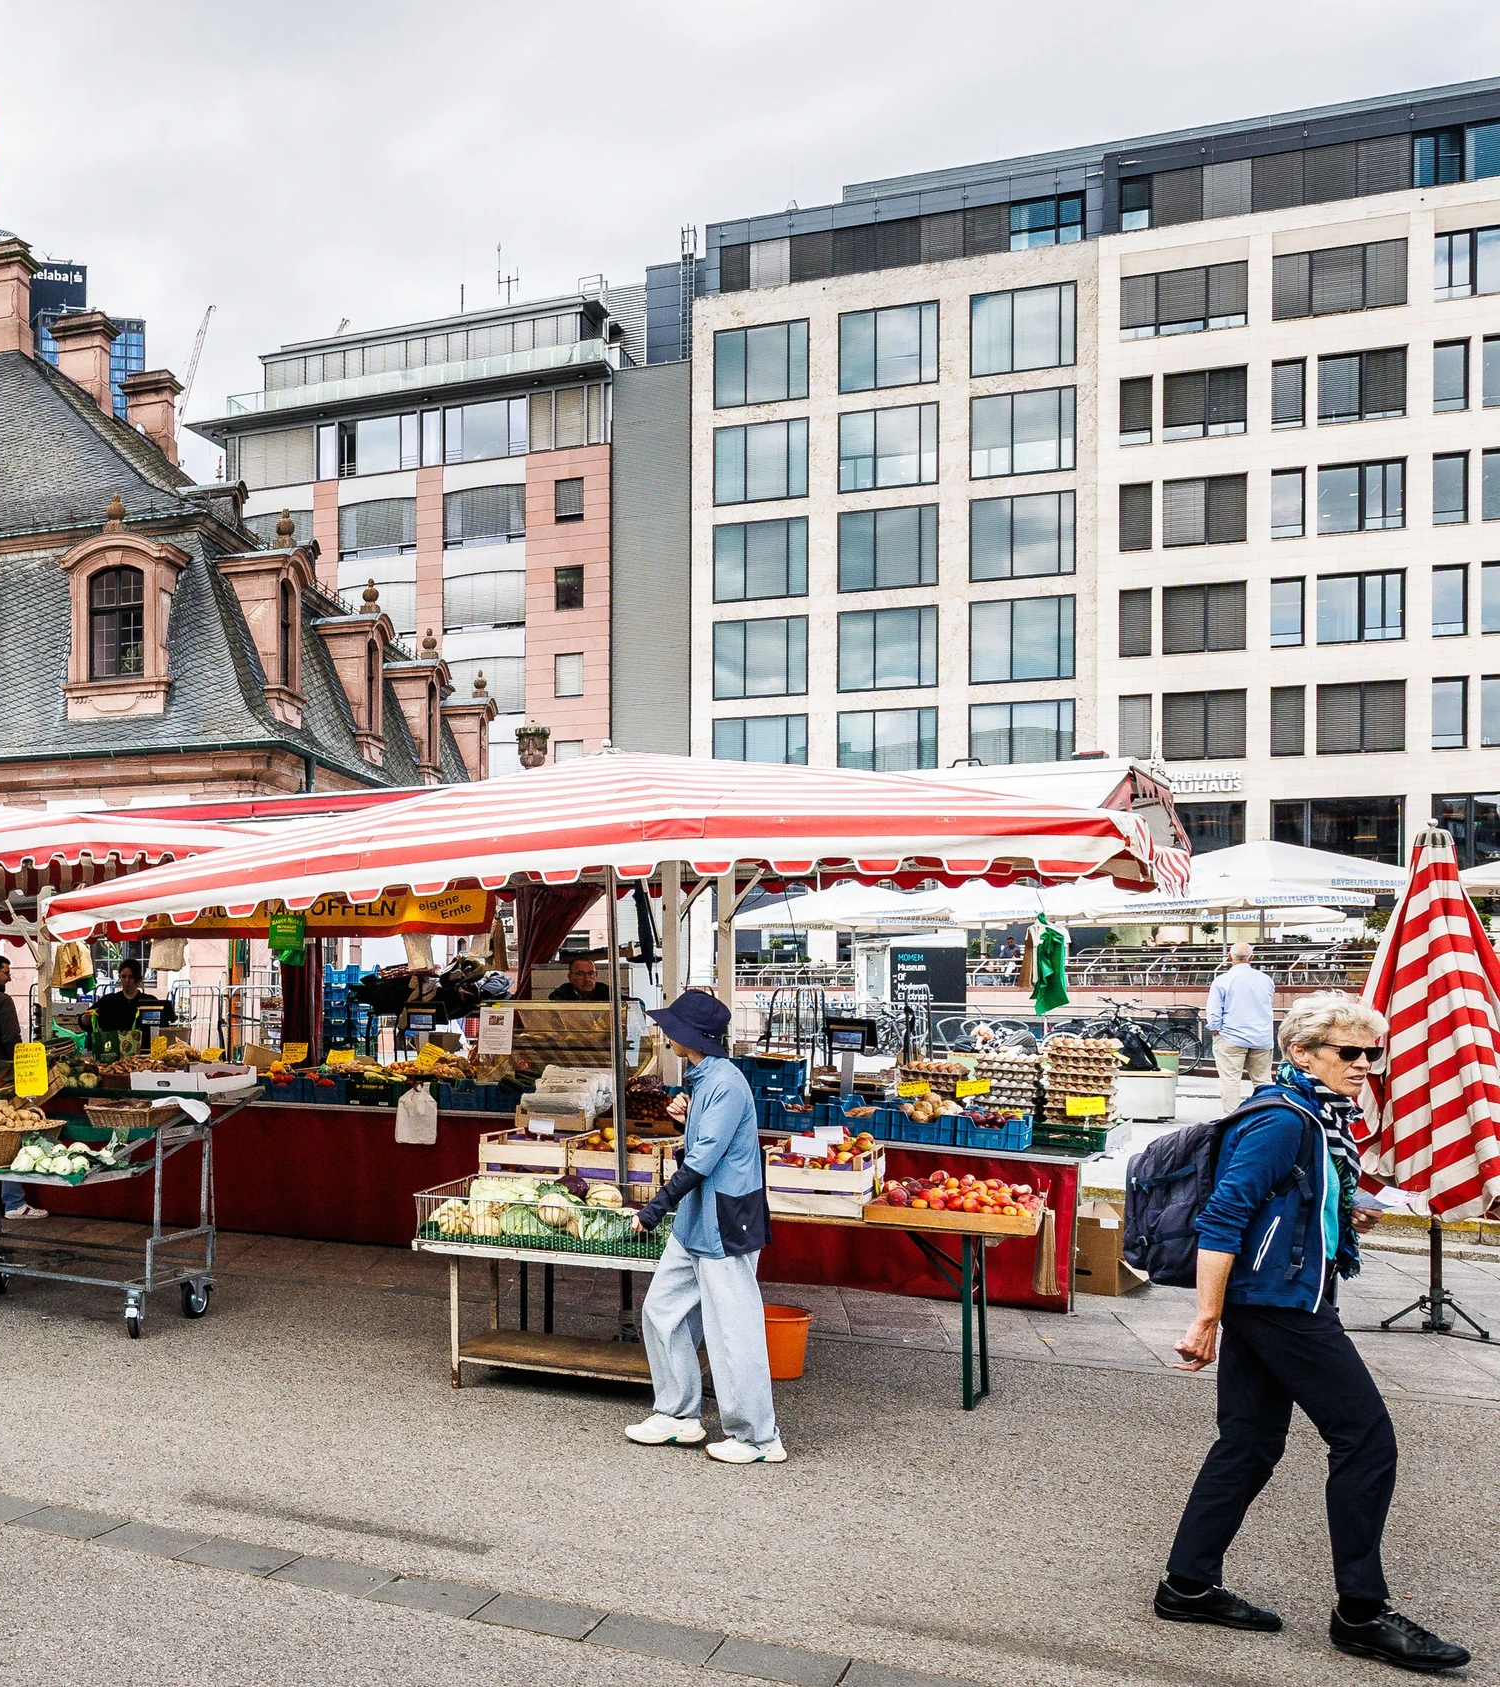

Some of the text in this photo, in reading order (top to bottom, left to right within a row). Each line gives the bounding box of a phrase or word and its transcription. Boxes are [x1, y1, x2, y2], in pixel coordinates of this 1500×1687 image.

[1169, 779, 1243, 794] AUHAUS
[1331, 878, 1379, 887] BAYREUTHER
[419, 895, 459, 911] eigene
[1255, 896, 1371, 904] BAYREUTHER BRAUHAUS
[440, 904, 472, 919] Ernte
[897, 954, 924, 962] MOMEM
[897, 972, 907, 981] Of
[897, 992, 934, 1001] Elctronc
